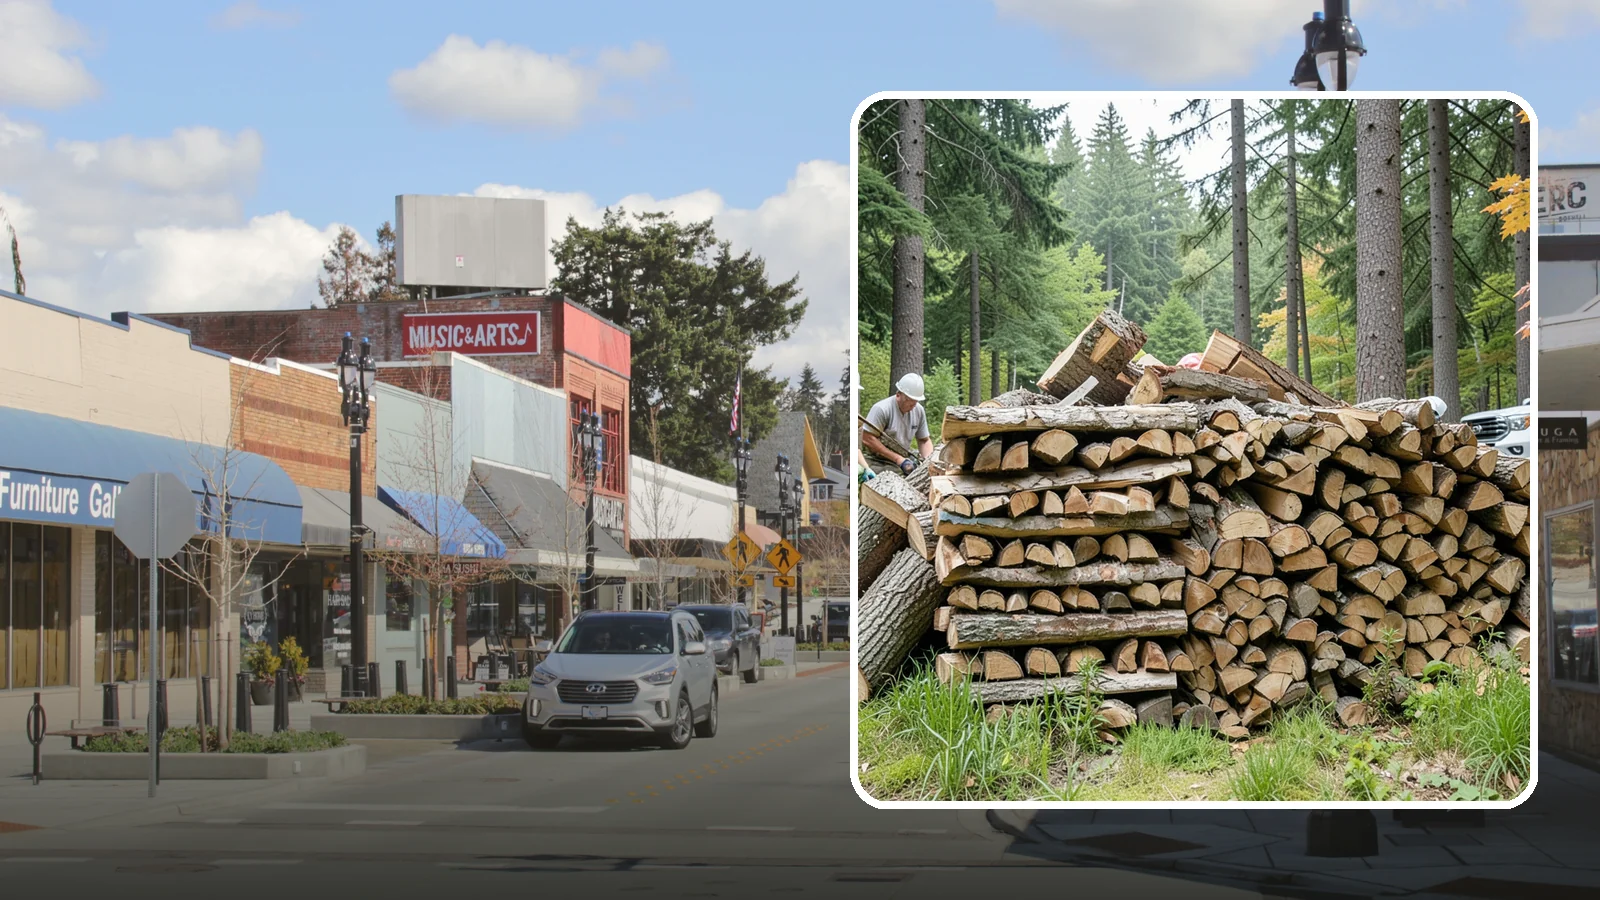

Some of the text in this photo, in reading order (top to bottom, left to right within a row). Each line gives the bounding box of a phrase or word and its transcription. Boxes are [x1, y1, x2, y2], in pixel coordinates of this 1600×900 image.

[409, 322, 520, 349] MUSIC&ARTS
[0, 471, 121, 519] Furniture Gal
[453, 563, 479, 575] SUSHI
